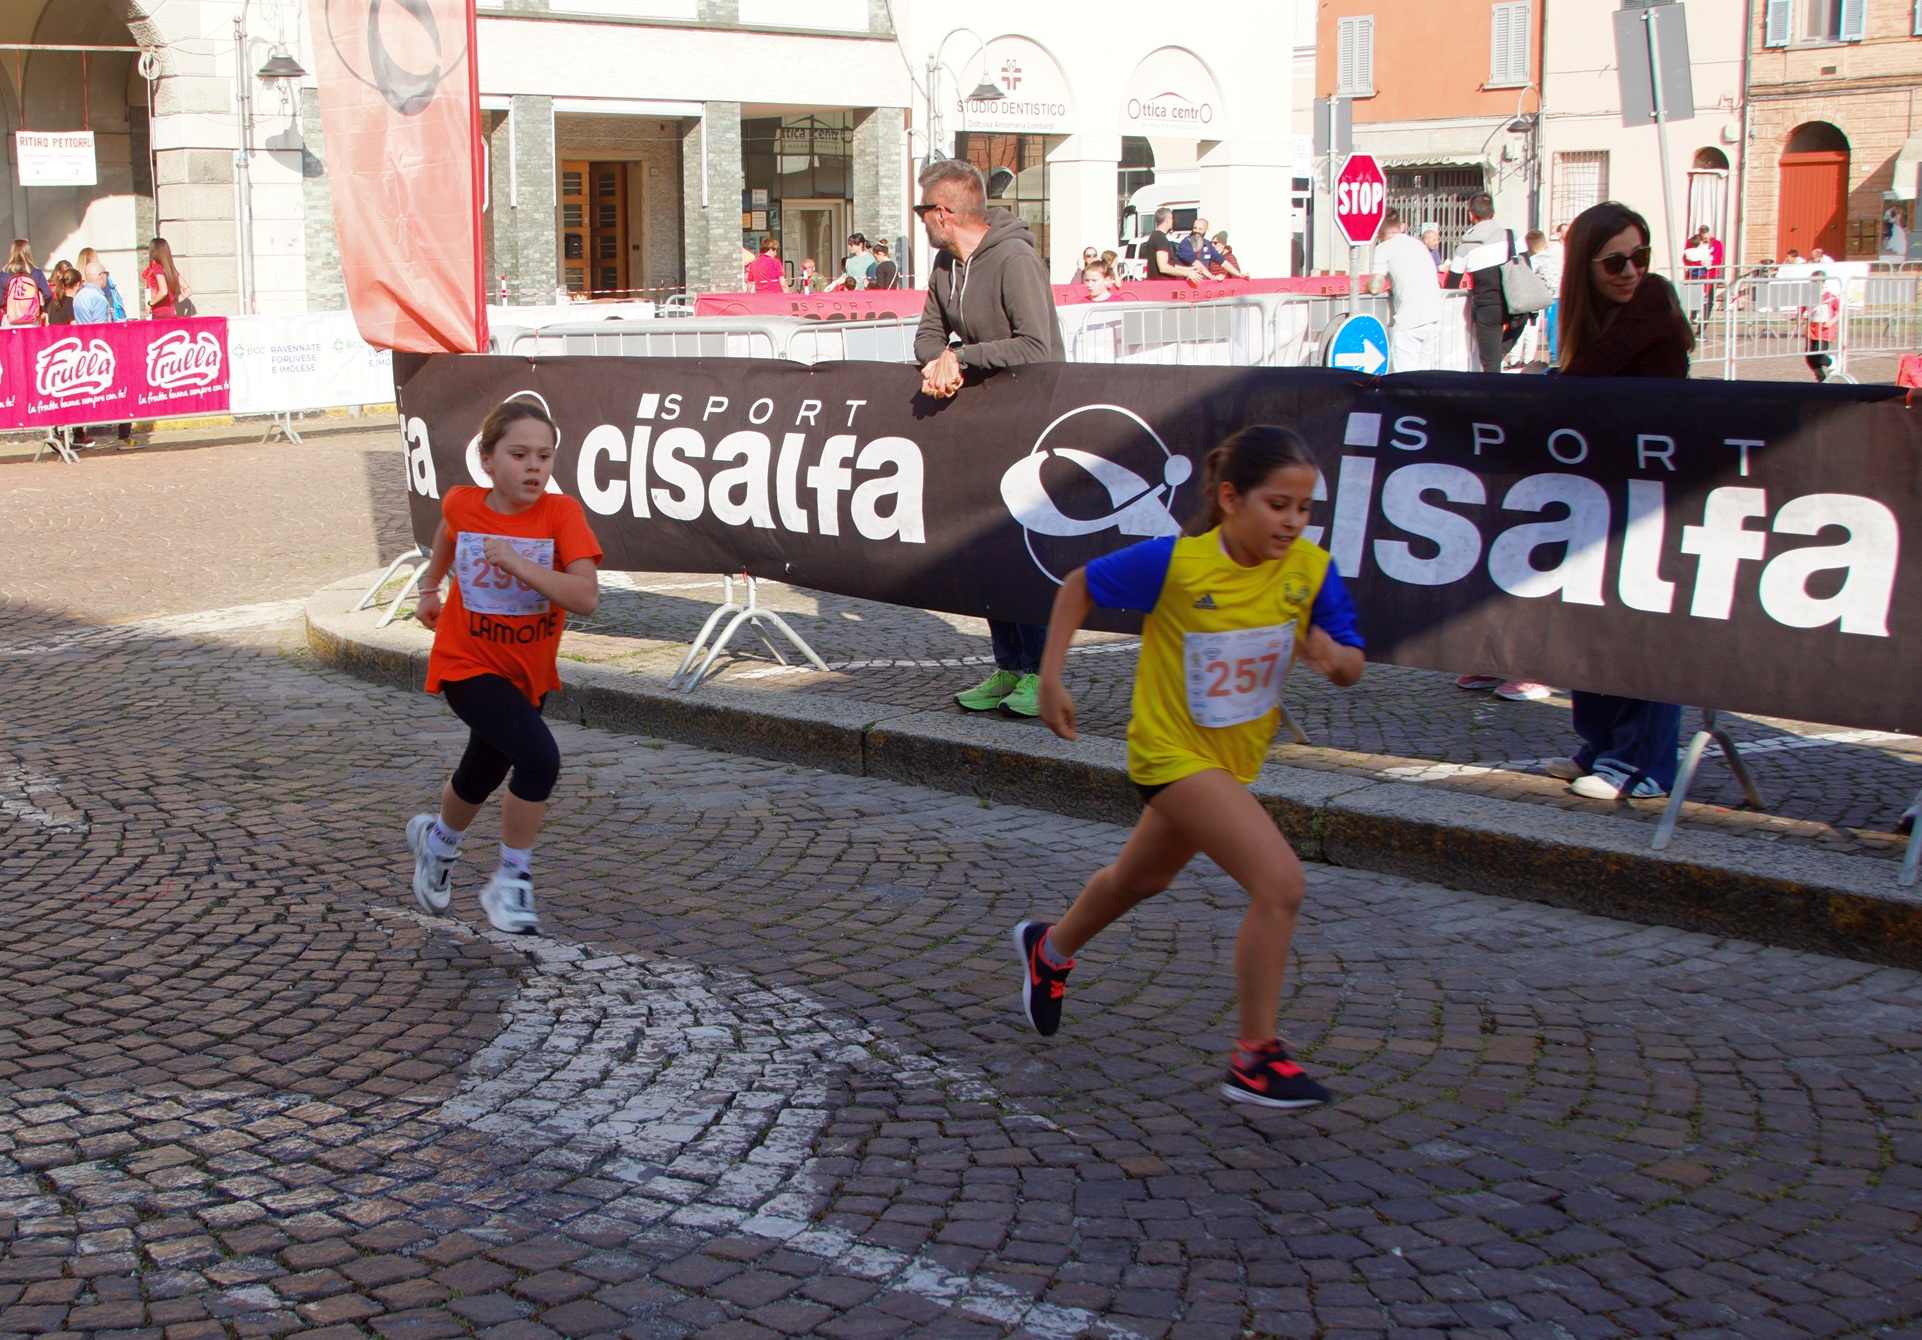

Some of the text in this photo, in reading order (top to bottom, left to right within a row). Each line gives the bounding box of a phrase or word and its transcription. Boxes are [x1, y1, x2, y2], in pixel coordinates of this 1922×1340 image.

[956, 99, 1066, 117] STUDIO DENTISTICO
[1127, 98, 1213, 124] Ottica centrO
[968, 120, 1055, 130] Dott.ssa Annamaria Lombardi
[19, 136, 94, 149] RITIRO PETTORALI
[1338, 181, 1383, 215] STOP
[1179, 289, 1237, 300] SPORT
[801, 301, 873, 312] SPORT
[247, 343, 321, 355] BCC RAVENNATE
[346, 340, 363, 349] BCC
[39, 339, 113, 393] Frulla
[148, 332, 219, 385] Frulla
[271, 353, 317, 364] FORLIVESE
[271, 364, 316, 374] E IMOLESE
[37, 399, 59, 414] frutta
[60, 397, 80, 409] buona
[81, 394, 105, 409] sempre
[147, 391, 168, 405] frutta
[168, 388, 188, 400] buona
[189, 385, 212, 399] sempre
[660, 393, 867, 428] SPORT
[1389, 415, 1766, 477] SPORT
[576, 393, 926, 544] cisalfa
[1205, 652, 1281, 698] 257
